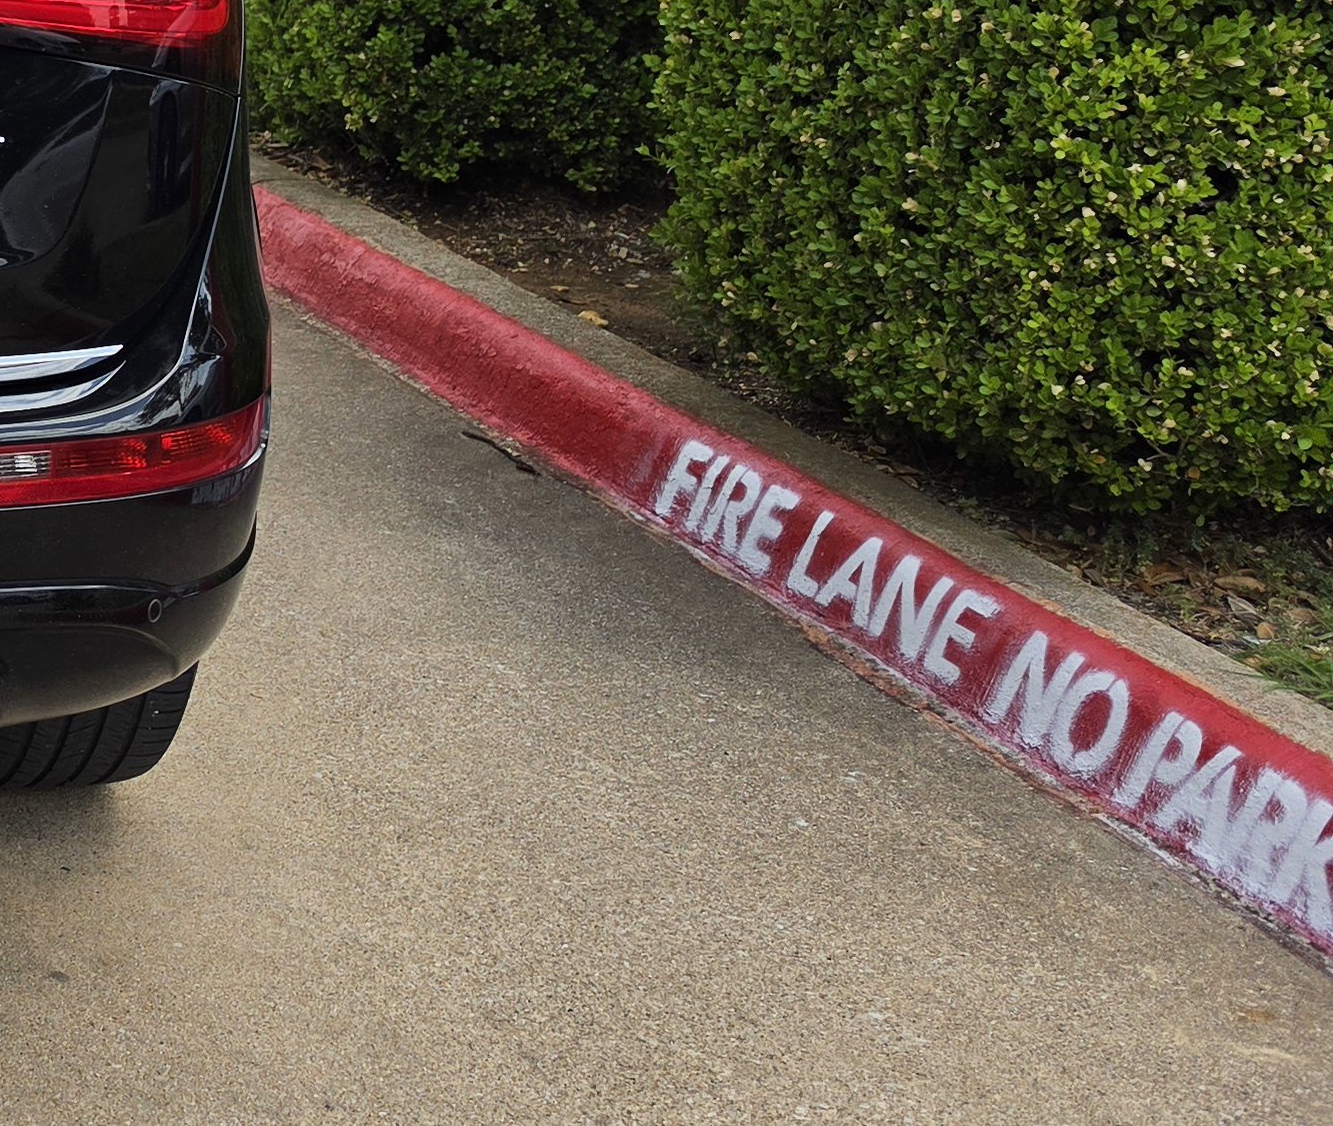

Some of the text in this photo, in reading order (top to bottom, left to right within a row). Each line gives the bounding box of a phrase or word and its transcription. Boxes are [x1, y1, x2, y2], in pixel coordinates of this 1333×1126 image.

[652, 439, 1333, 940] FIRE LANE NO PARK
